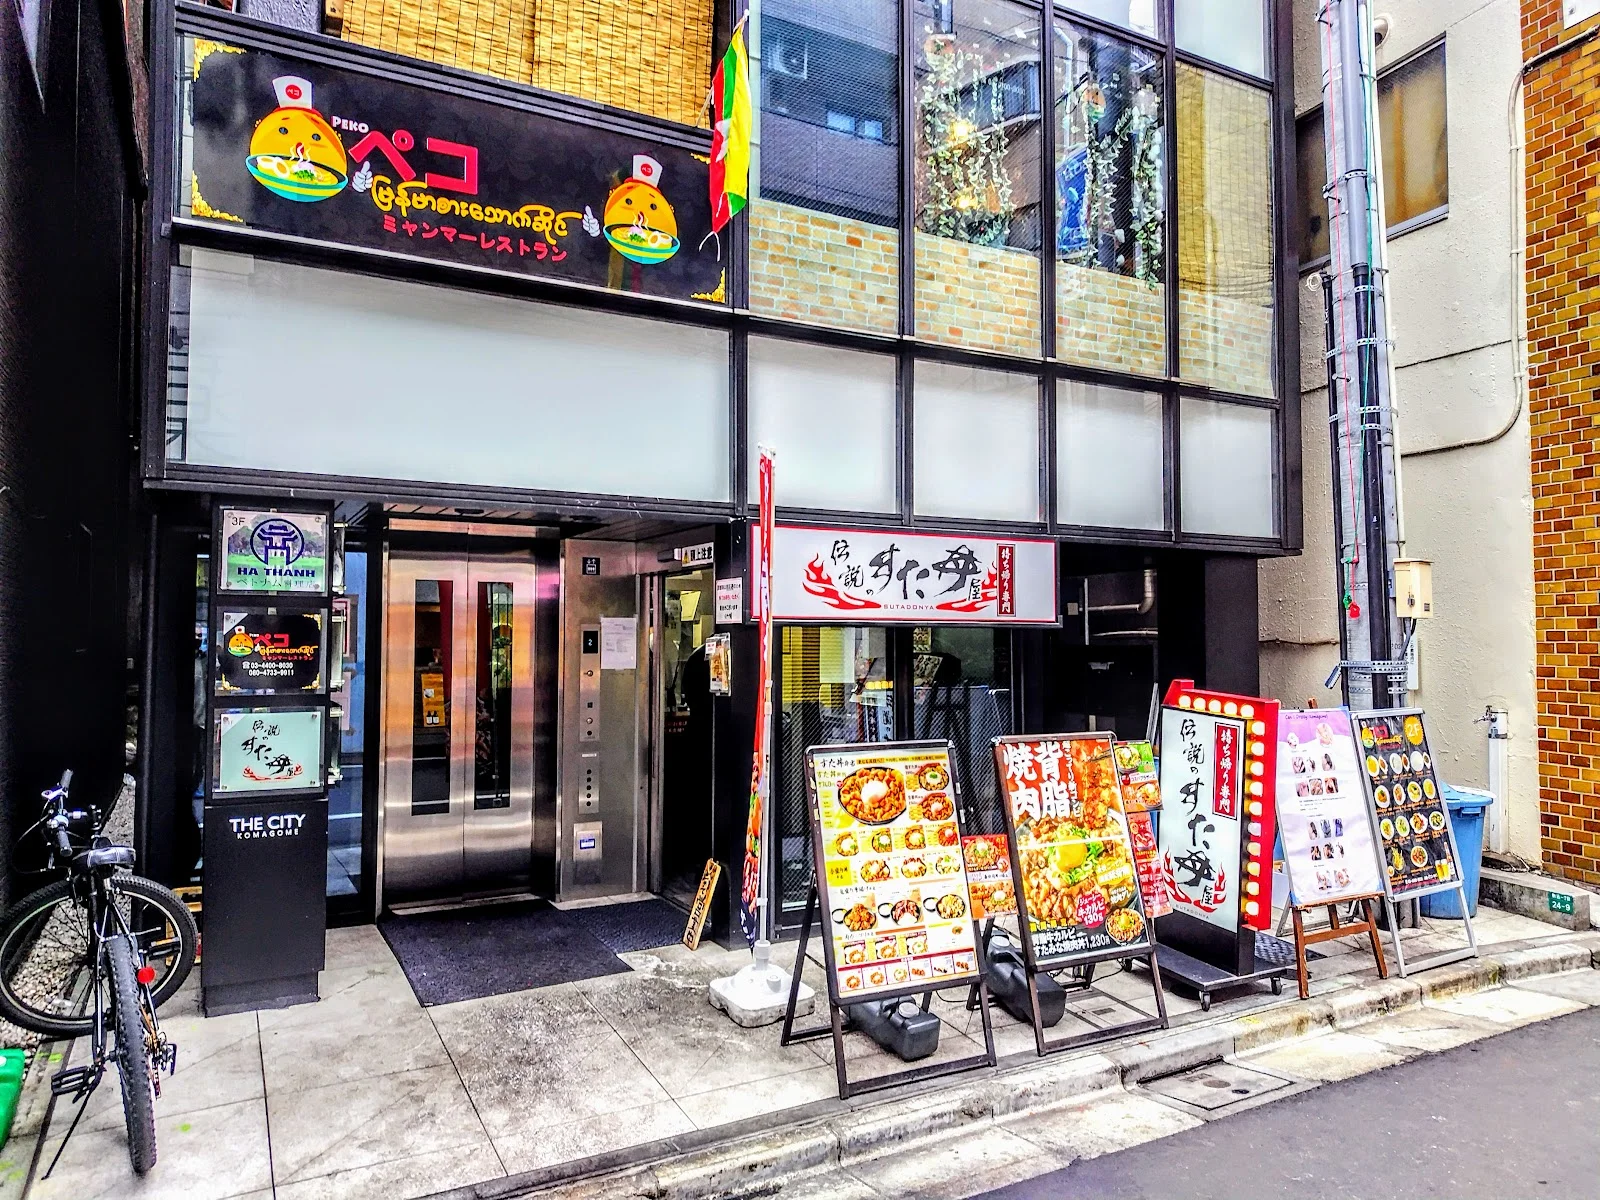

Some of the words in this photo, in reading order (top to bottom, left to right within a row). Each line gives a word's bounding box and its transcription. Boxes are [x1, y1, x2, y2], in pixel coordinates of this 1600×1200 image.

[331, 116, 369, 134] PEKO
[348, 129, 478, 195] ペコ
[383, 215, 567, 262] ミャンマーレストラン
[232, 516, 246, 526] 3F
[237, 567, 259, 576] HA
[264, 568, 316, 578] THANH
[1001, 548, 1012, 614] 持ち帰り専門
[254, 633, 290, 648] ペコ
[1408, 723, 1420, 737] 2F
[1219, 729, 1234, 814] 持ち帰り専門
[229, 817, 263, 833] THE
[267, 813, 306, 830] CITY
[237, 828, 299, 840] KOMAGOME
[1077, 898, 1105, 918] 牛カルビ
[1551, 900, 1571, 912] 24-9
